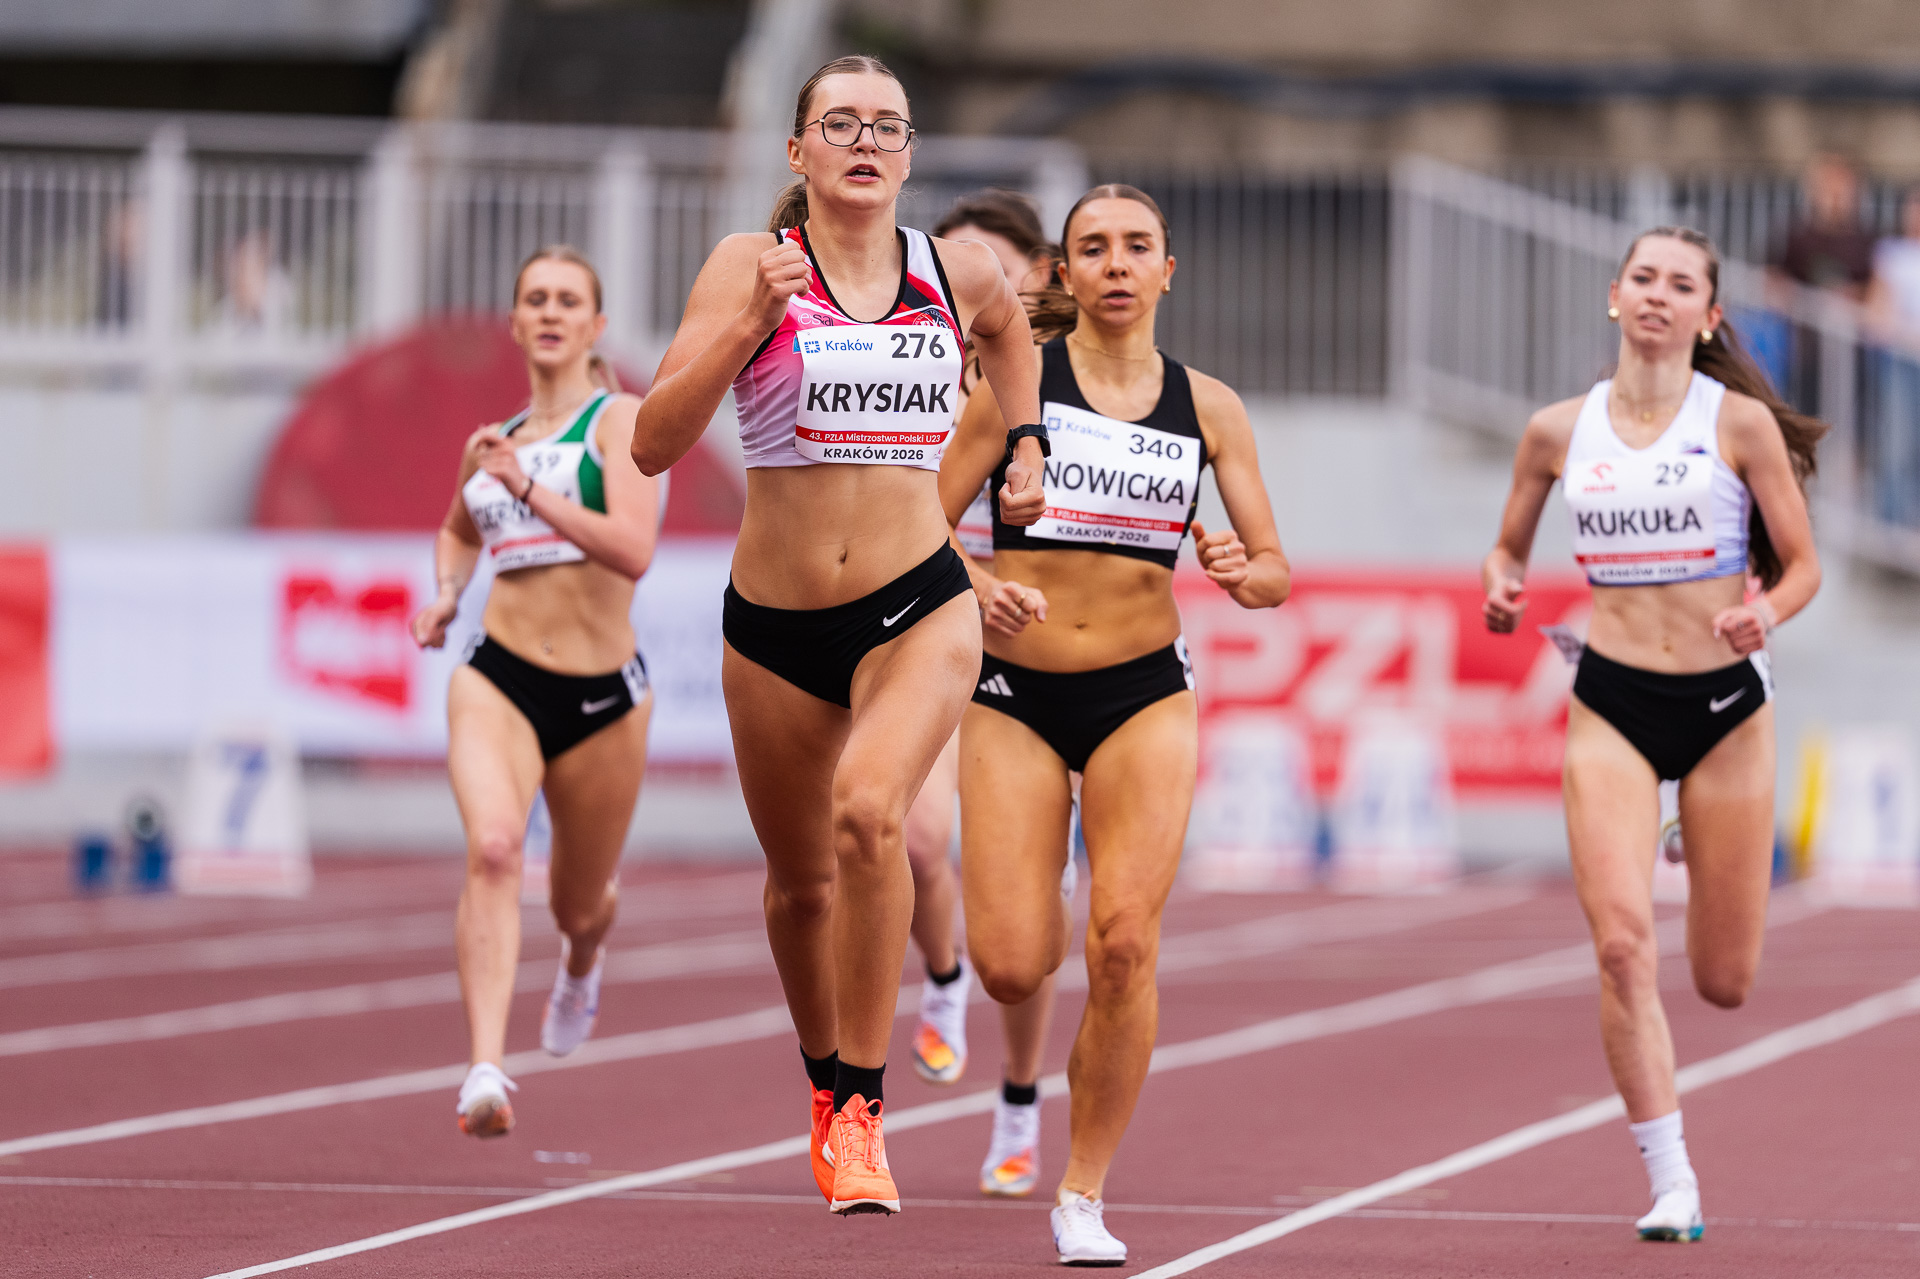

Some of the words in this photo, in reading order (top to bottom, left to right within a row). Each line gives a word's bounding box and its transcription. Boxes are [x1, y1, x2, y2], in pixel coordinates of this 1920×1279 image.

[825, 339, 874, 351] Kraków
[890, 332, 946, 359] 276
[806, 382, 951, 413] KRYSIAK
[809, 432, 823, 441] 43.
[824, 433, 844, 442] PZLA
[845, 433, 898, 442] Mistrzostwa
[899, 434, 924, 443] Polski
[925, 434, 941, 443] U23
[1065, 421, 1112, 441] Kraków
[823, 446, 889, 460] KRAKÓW
[891, 449, 924, 460] 2026
[1129, 433, 1183, 460] 340
[1042, 460, 1185, 505] NOWICKA
[1655, 461, 1688, 485] 29
[1577, 506, 1703, 537] KUKUŁA
[1056, 525, 1117, 539] KRAKÓW
[1119, 531, 1151, 543] 2026
